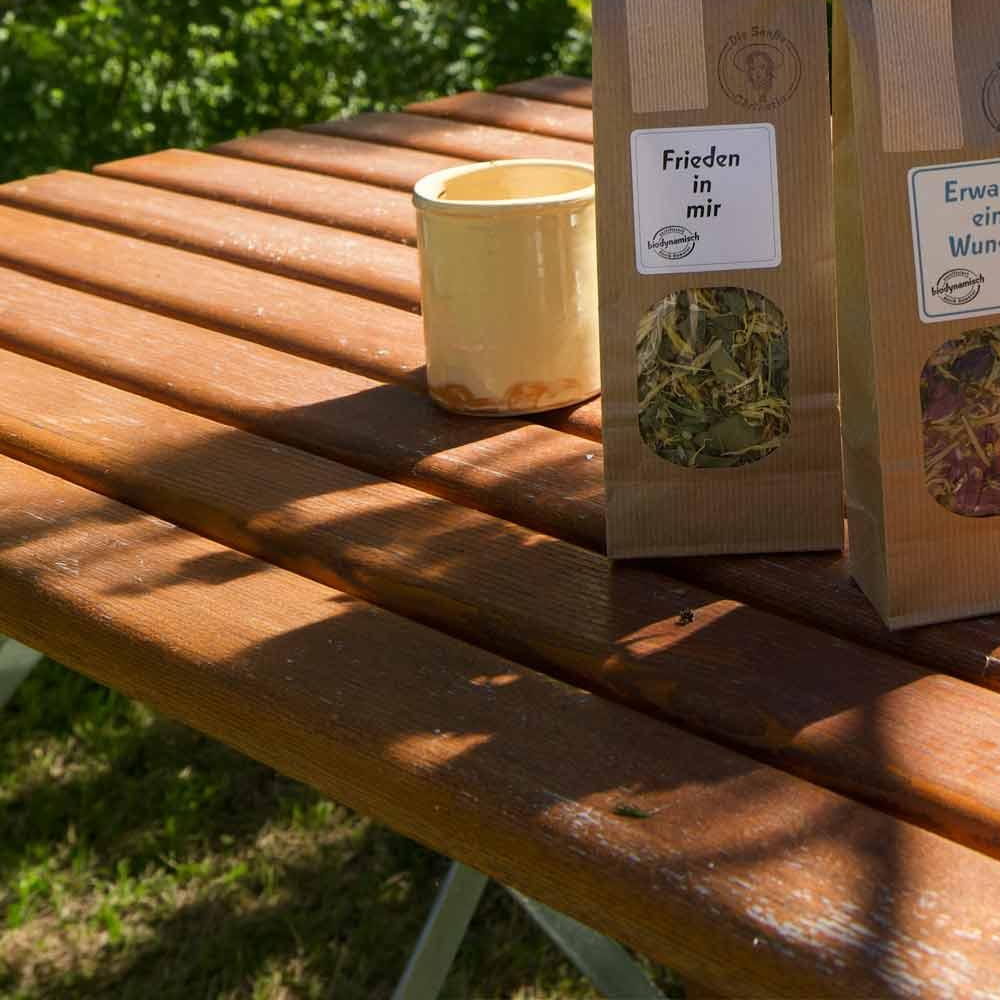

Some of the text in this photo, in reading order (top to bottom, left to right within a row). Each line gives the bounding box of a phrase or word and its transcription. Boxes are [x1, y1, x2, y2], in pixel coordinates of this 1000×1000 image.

[662, 145, 741, 171] Frieden
[692, 174, 712, 194] in
[686, 198, 722, 219] mir
[647, 231, 700, 250] biodynamisch
[931, 273, 985, 296] biodynamisch
